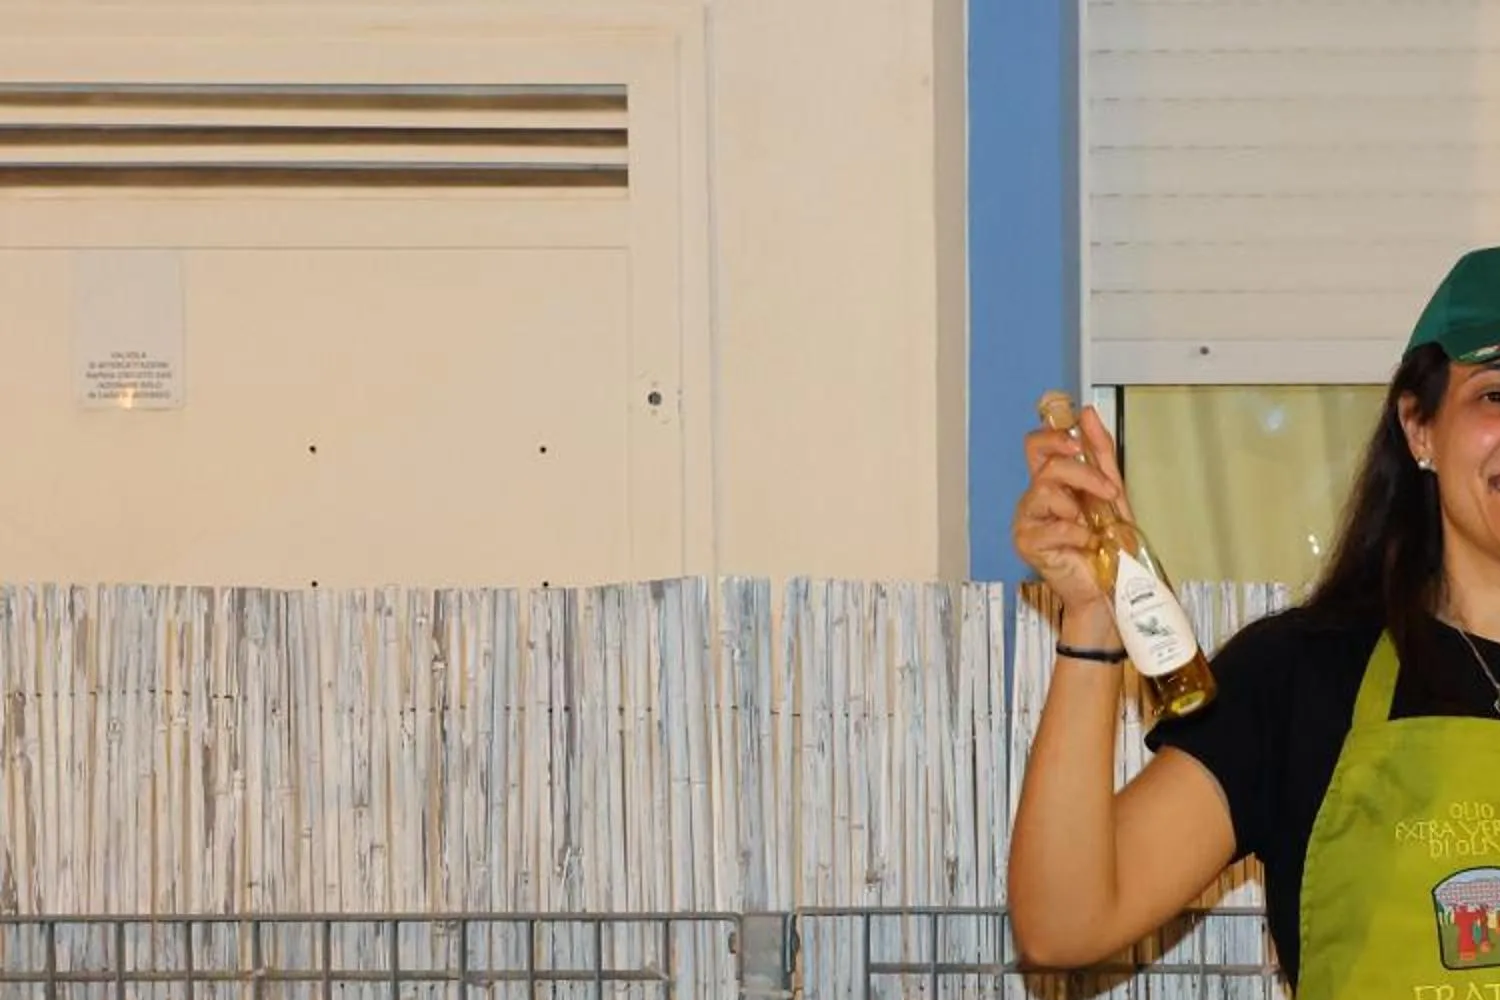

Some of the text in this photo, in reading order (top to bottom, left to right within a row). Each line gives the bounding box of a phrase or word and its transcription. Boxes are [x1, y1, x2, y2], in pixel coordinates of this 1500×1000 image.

[1450, 801, 1494, 820] OLIO
[1394, 820, 1456, 841] EXTRA
[1429, 838, 1450, 859] DI
